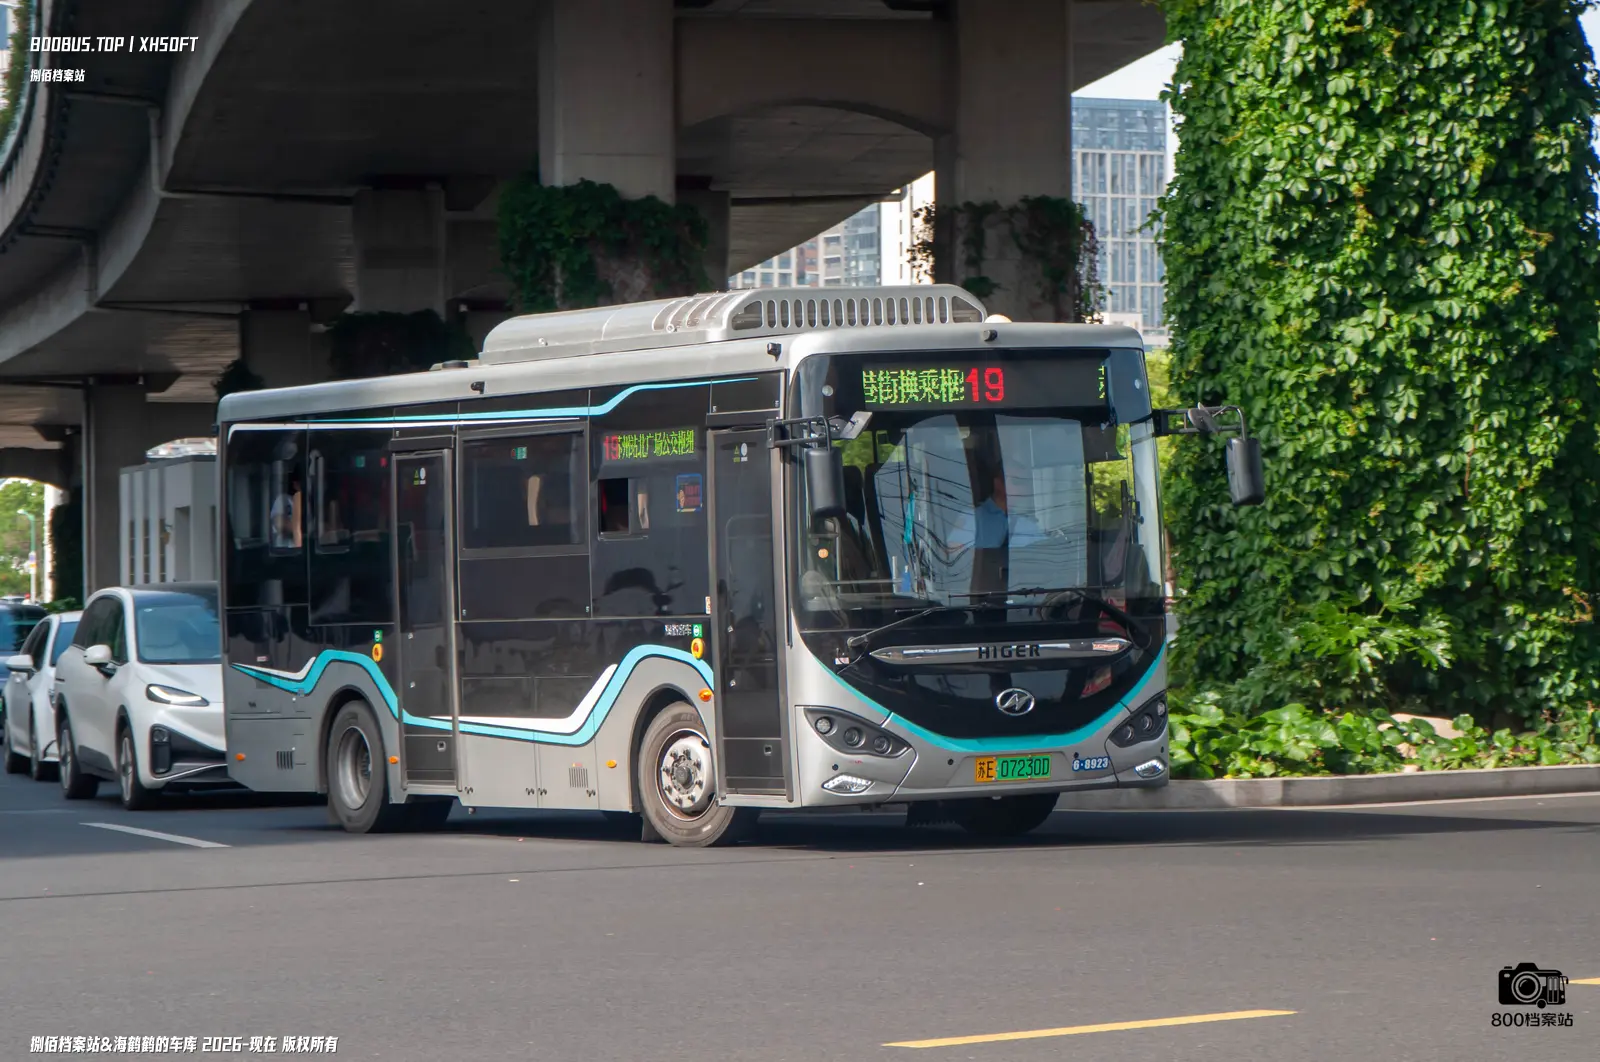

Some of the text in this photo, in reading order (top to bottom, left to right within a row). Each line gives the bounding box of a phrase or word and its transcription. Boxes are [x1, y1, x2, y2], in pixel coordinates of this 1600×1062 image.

[965, 367, 1005, 403] 19
[978, 644, 1041, 660] HIGER
[1000, 757, 1050, 779] 07230D
